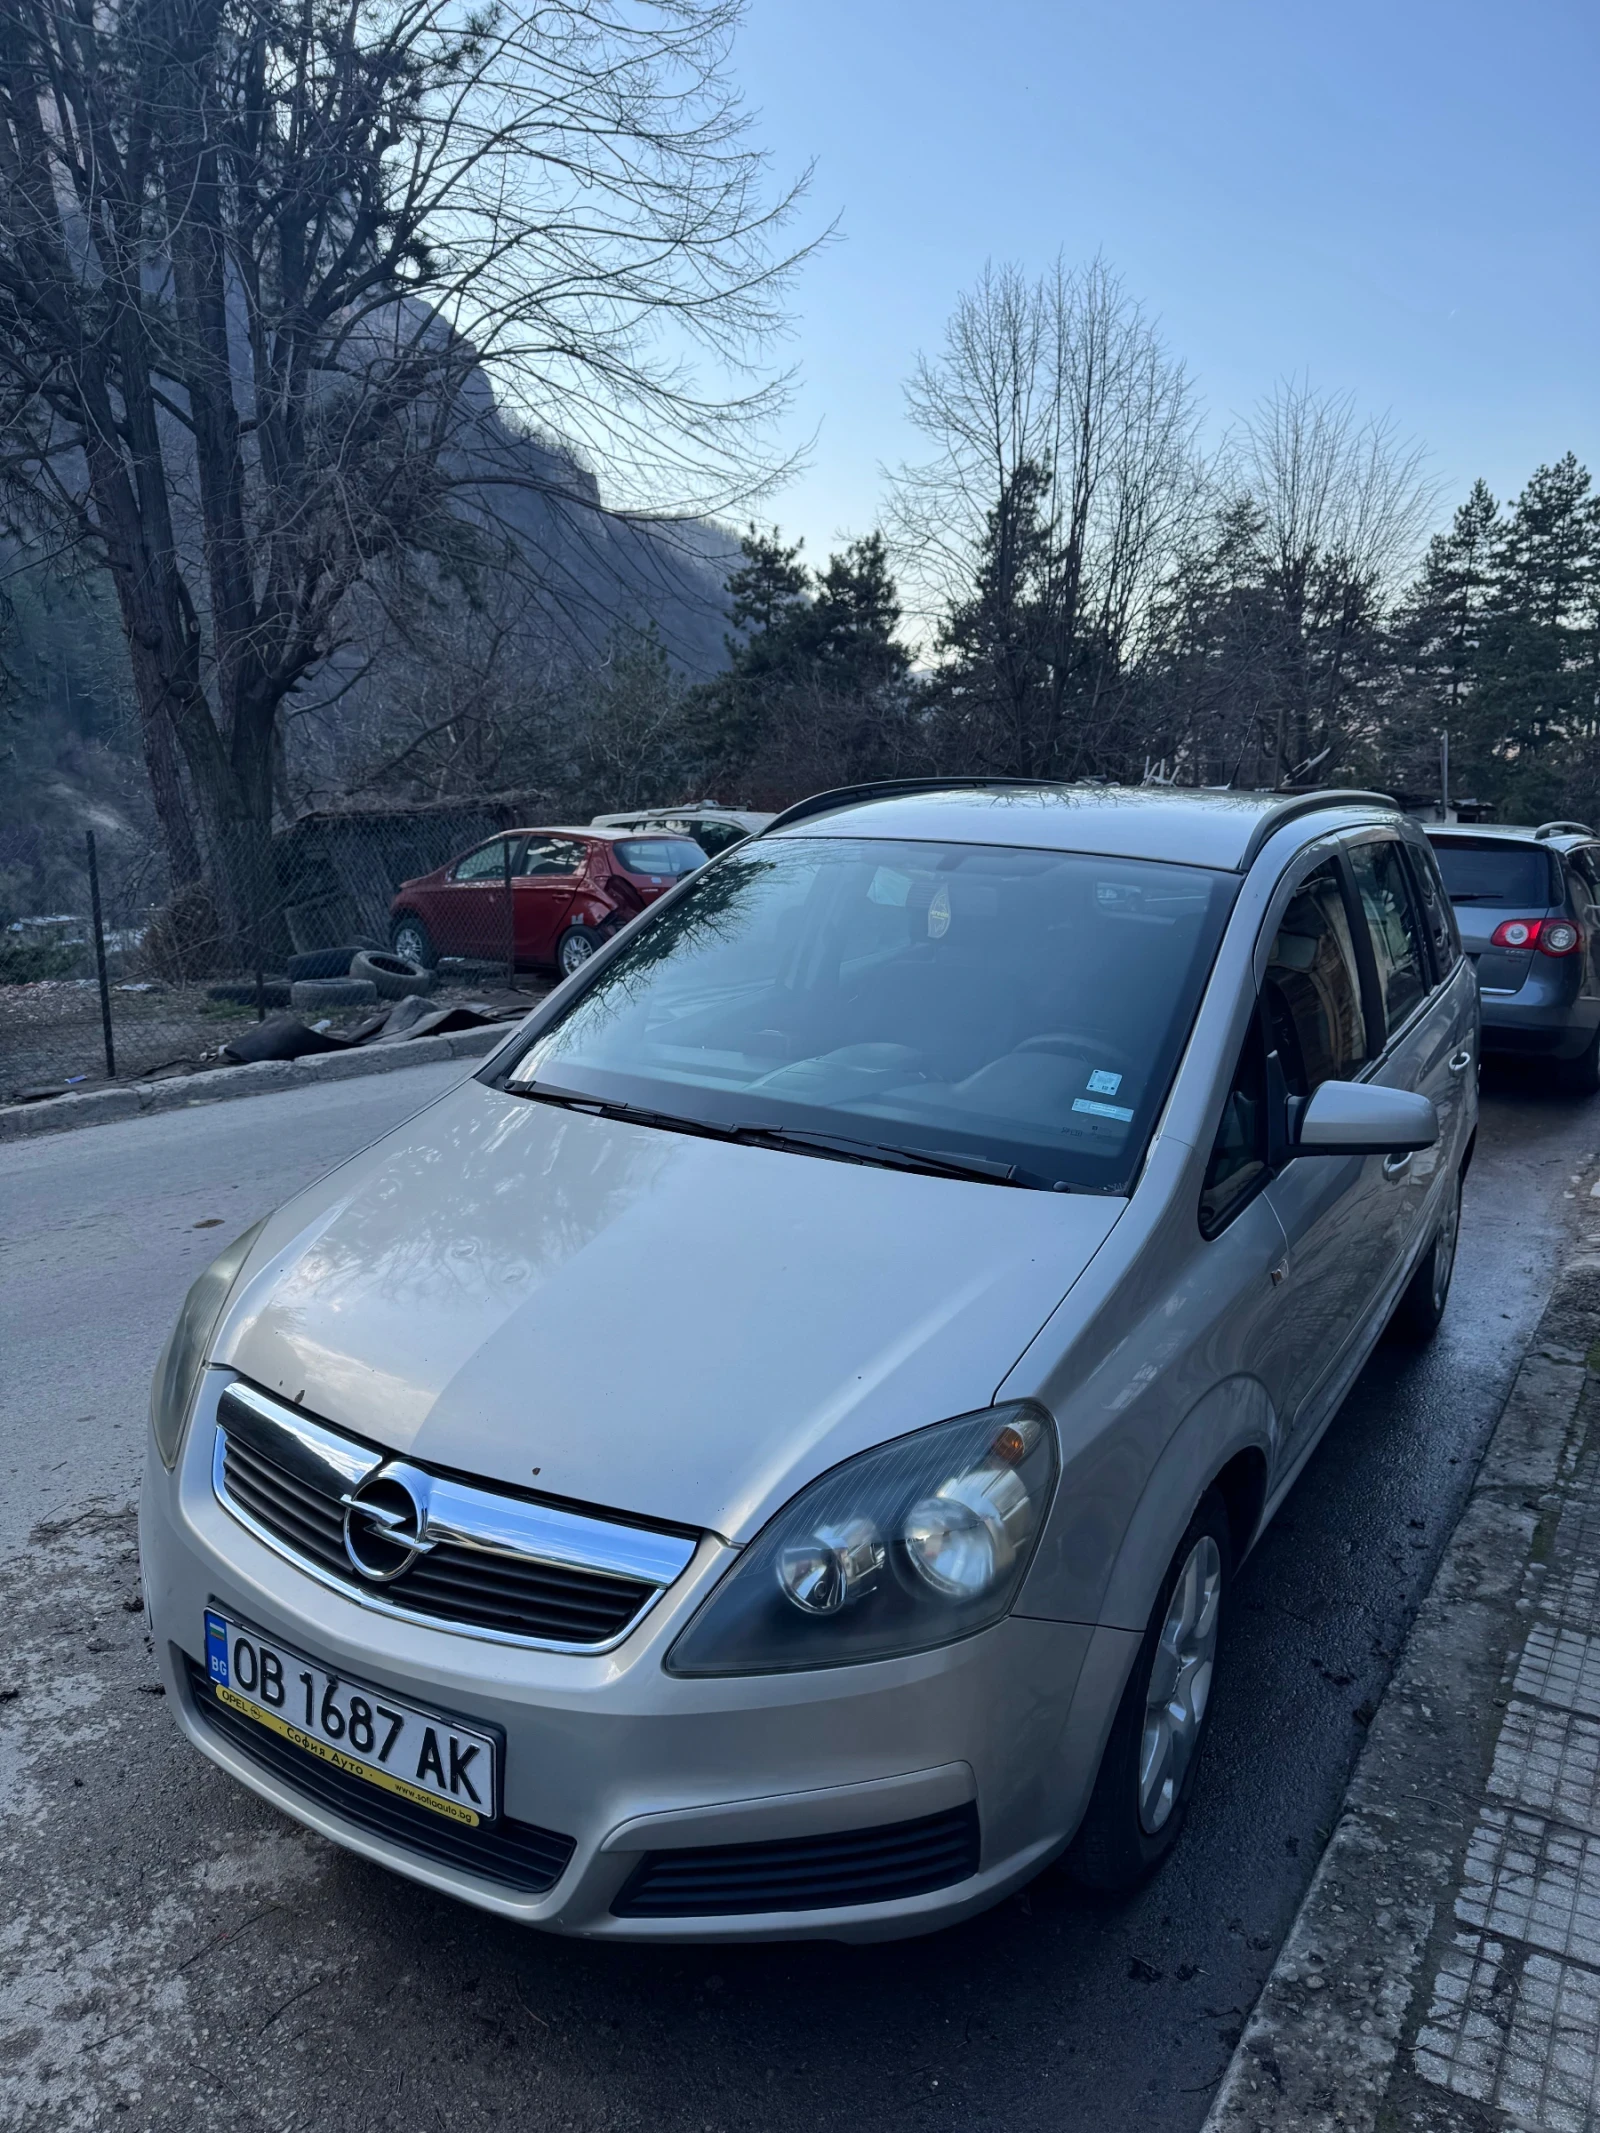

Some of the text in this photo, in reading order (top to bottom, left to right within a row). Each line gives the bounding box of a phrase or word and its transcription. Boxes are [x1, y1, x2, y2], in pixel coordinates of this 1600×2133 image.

[211, 1655, 227, 1676] BG
[222, 1690, 248, 1713] OPEL
[233, 1637, 482, 1804] OB 1687 AK
[286, 1728, 364, 1776] София Ауто
[394, 1783, 473, 1823] www.sofiaauto.bg
